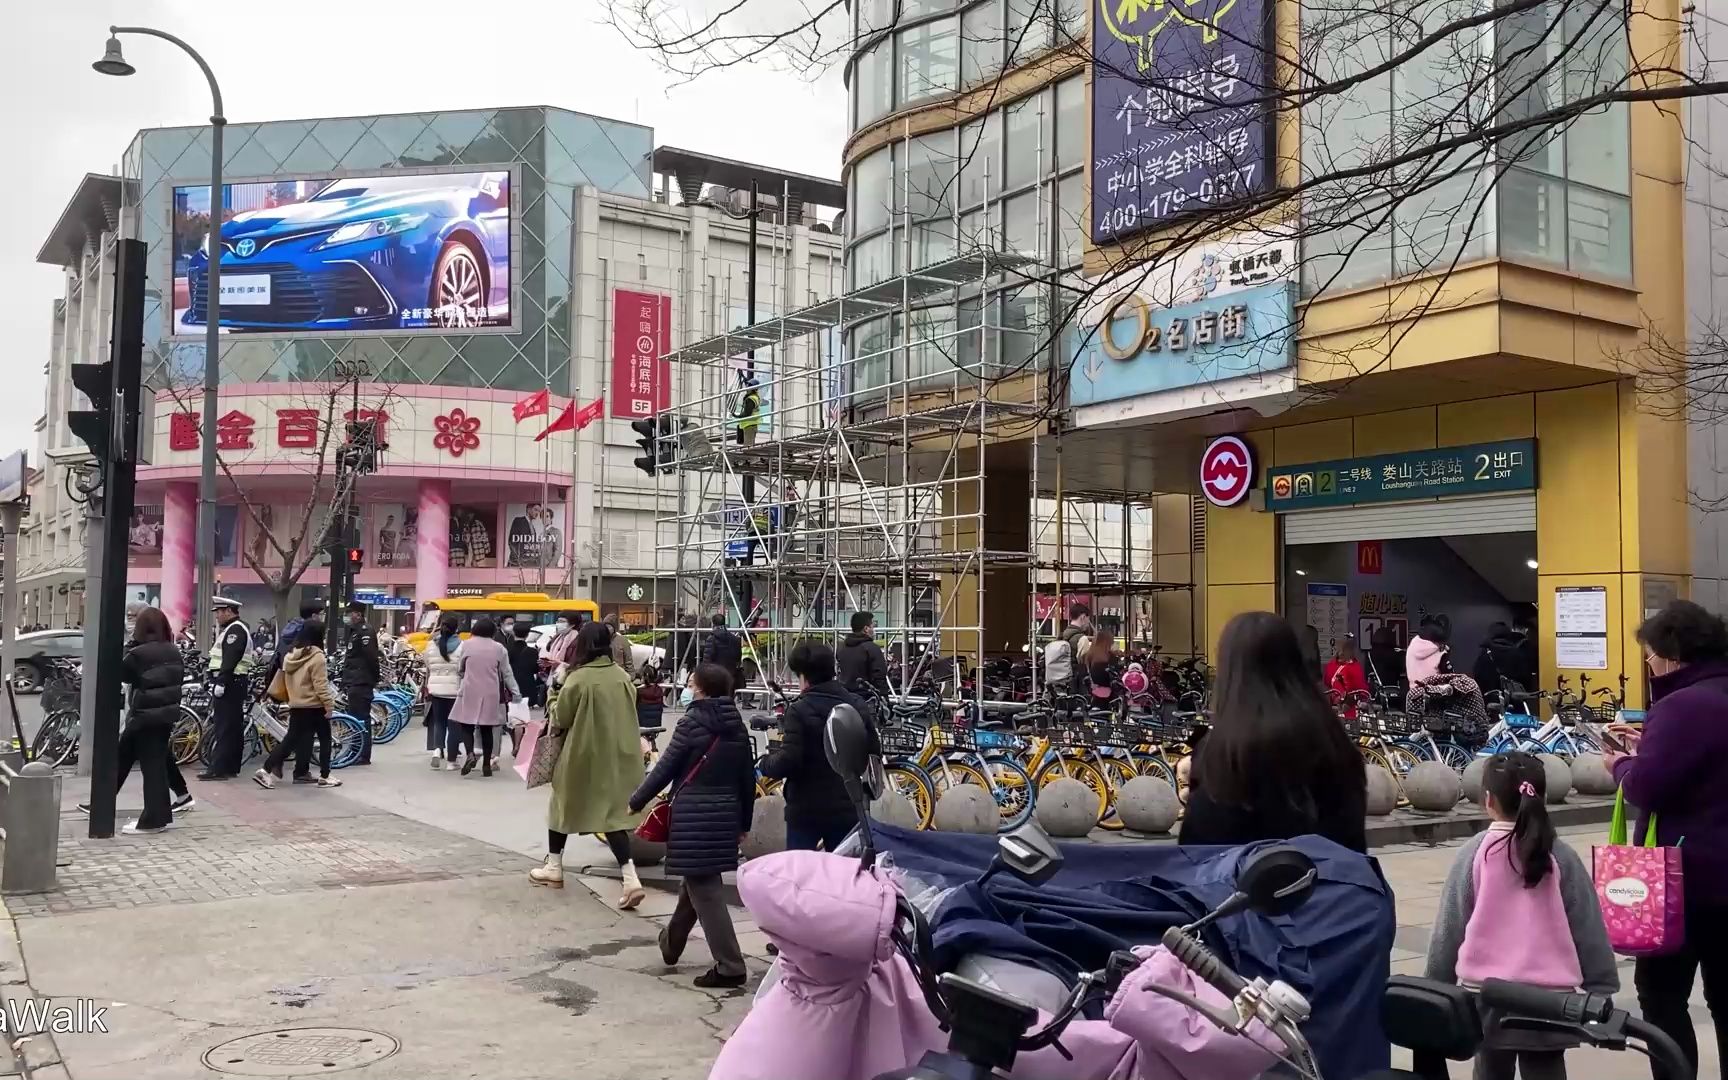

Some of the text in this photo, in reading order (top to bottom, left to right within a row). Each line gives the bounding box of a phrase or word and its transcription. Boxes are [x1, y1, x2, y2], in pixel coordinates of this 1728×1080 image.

[1115, 54, 1240, 135] 个别指导
[1107, 127, 1249, 197] 中小学全科辅导
[639, 355, 651, 394] 海底捞
[634, 401, 648, 411] 5F
[1320, 451, 1523, 492] 2 二号线 娄山关路站 2 出口
[1441, 476, 1464, 484] Station
[1494, 469, 1511, 479] EXIT
